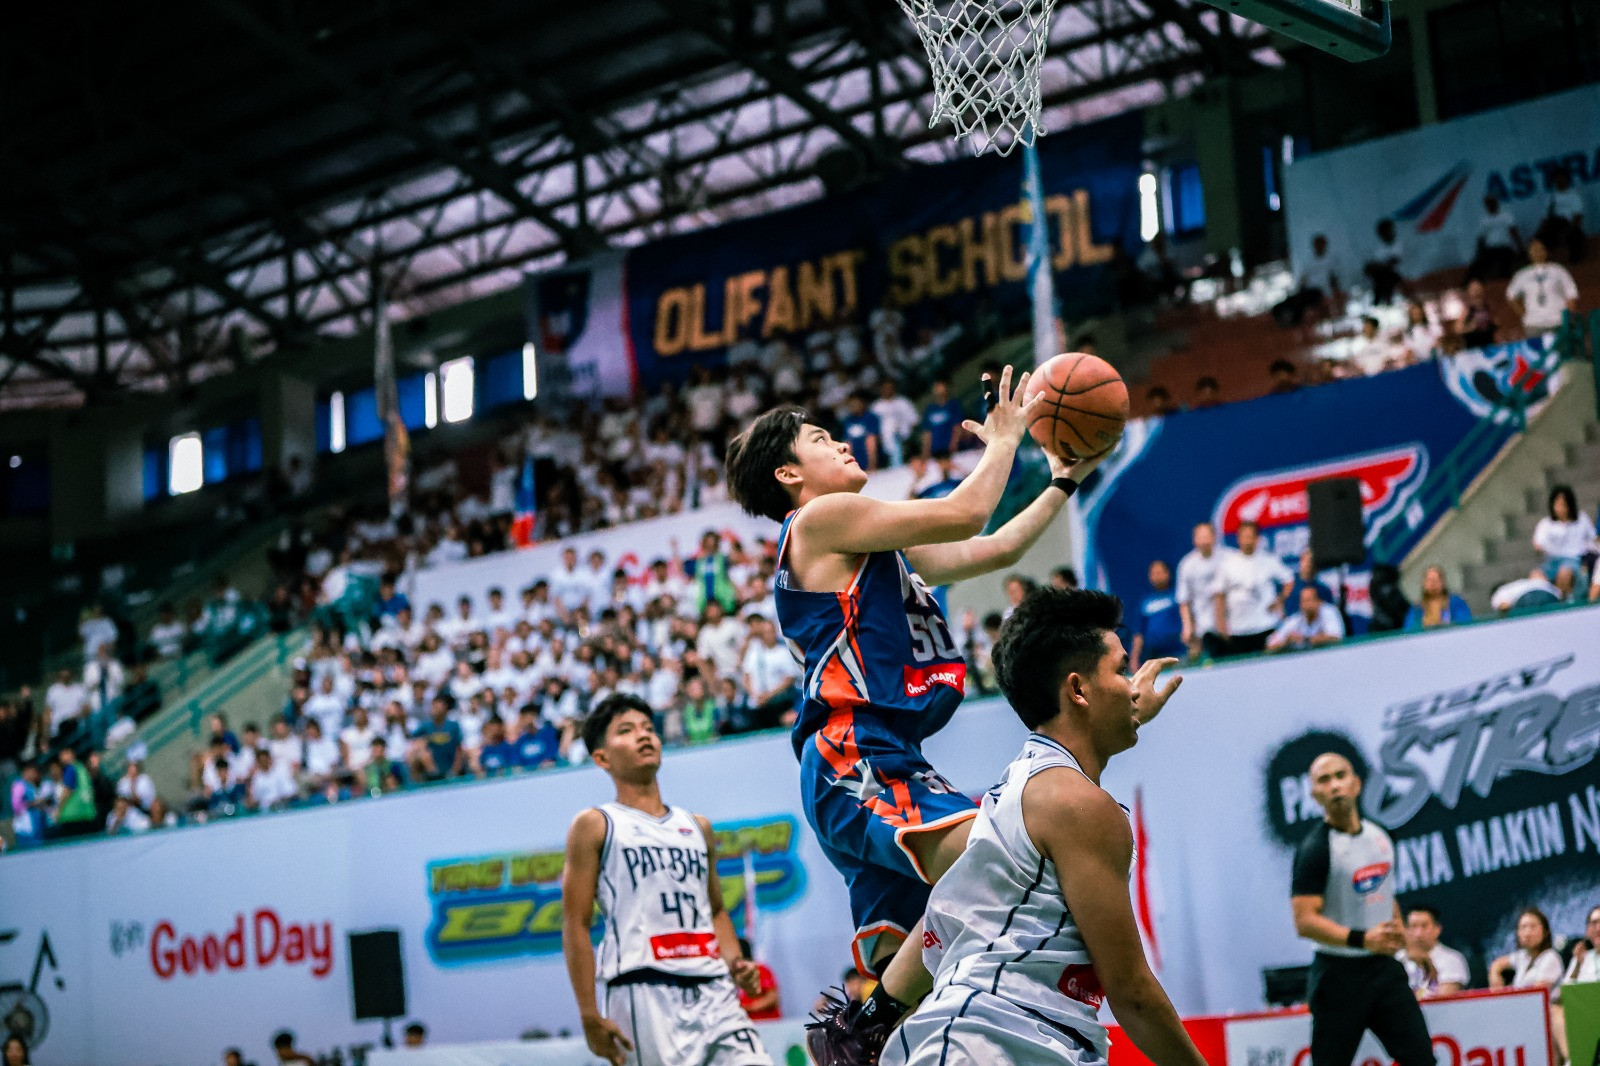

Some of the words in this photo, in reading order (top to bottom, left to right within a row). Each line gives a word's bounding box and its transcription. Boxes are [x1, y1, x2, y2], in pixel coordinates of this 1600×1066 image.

[653, 251, 862, 357] OLIFANT
[889, 189, 1114, 304] SCHOOL
[907, 682, 927, 694] One
[1393, 830, 1455, 895] AYA
[1456, 801, 1567, 878] MAKIN
[1568, 783, 1600, 856] N
[660, 891, 700, 929] 47
